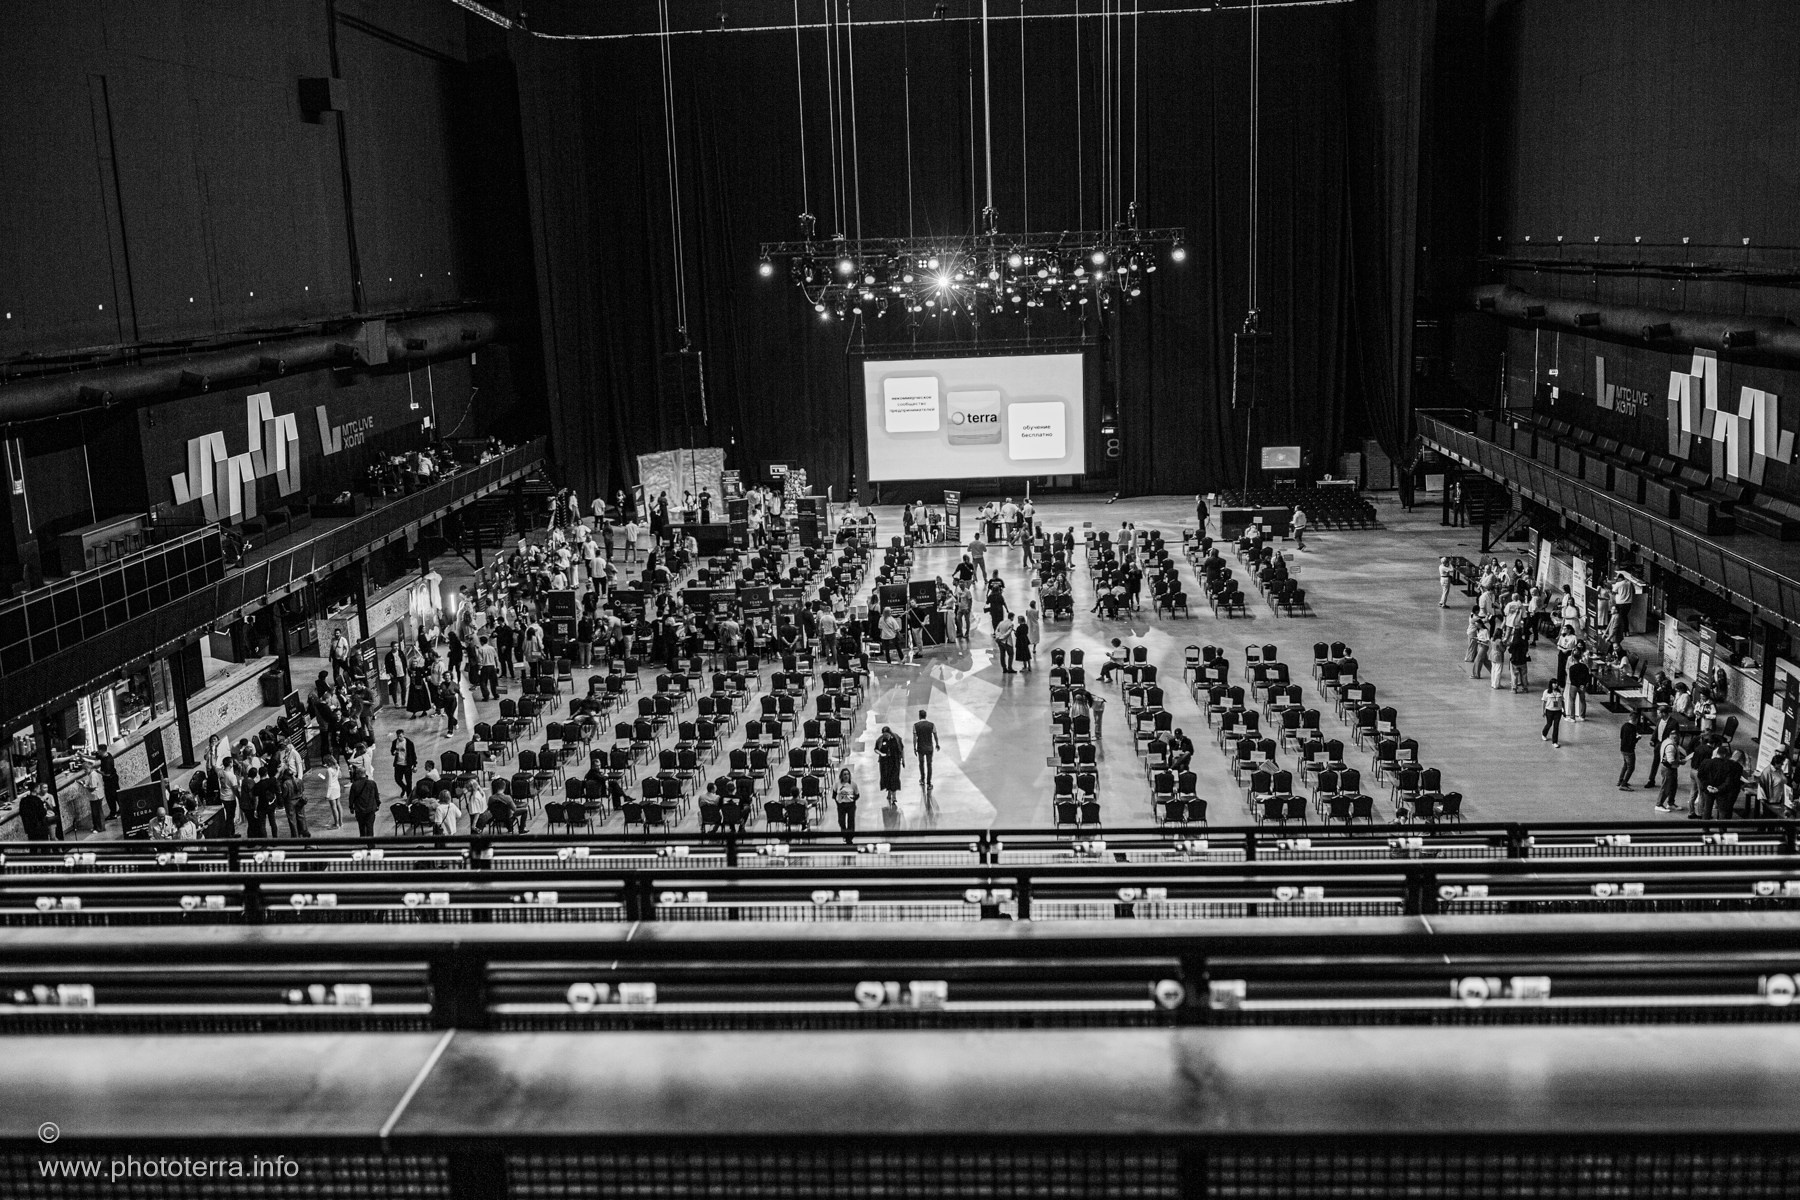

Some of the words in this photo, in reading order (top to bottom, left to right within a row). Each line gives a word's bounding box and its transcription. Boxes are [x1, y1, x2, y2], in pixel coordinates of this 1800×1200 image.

[1632, 389, 1649, 407] LIVE
[967, 411, 998, 423] terra
[342, 421, 358, 436] МТС
[358, 415, 374, 432] LIVE
[133, 808, 152, 817] TERRA
